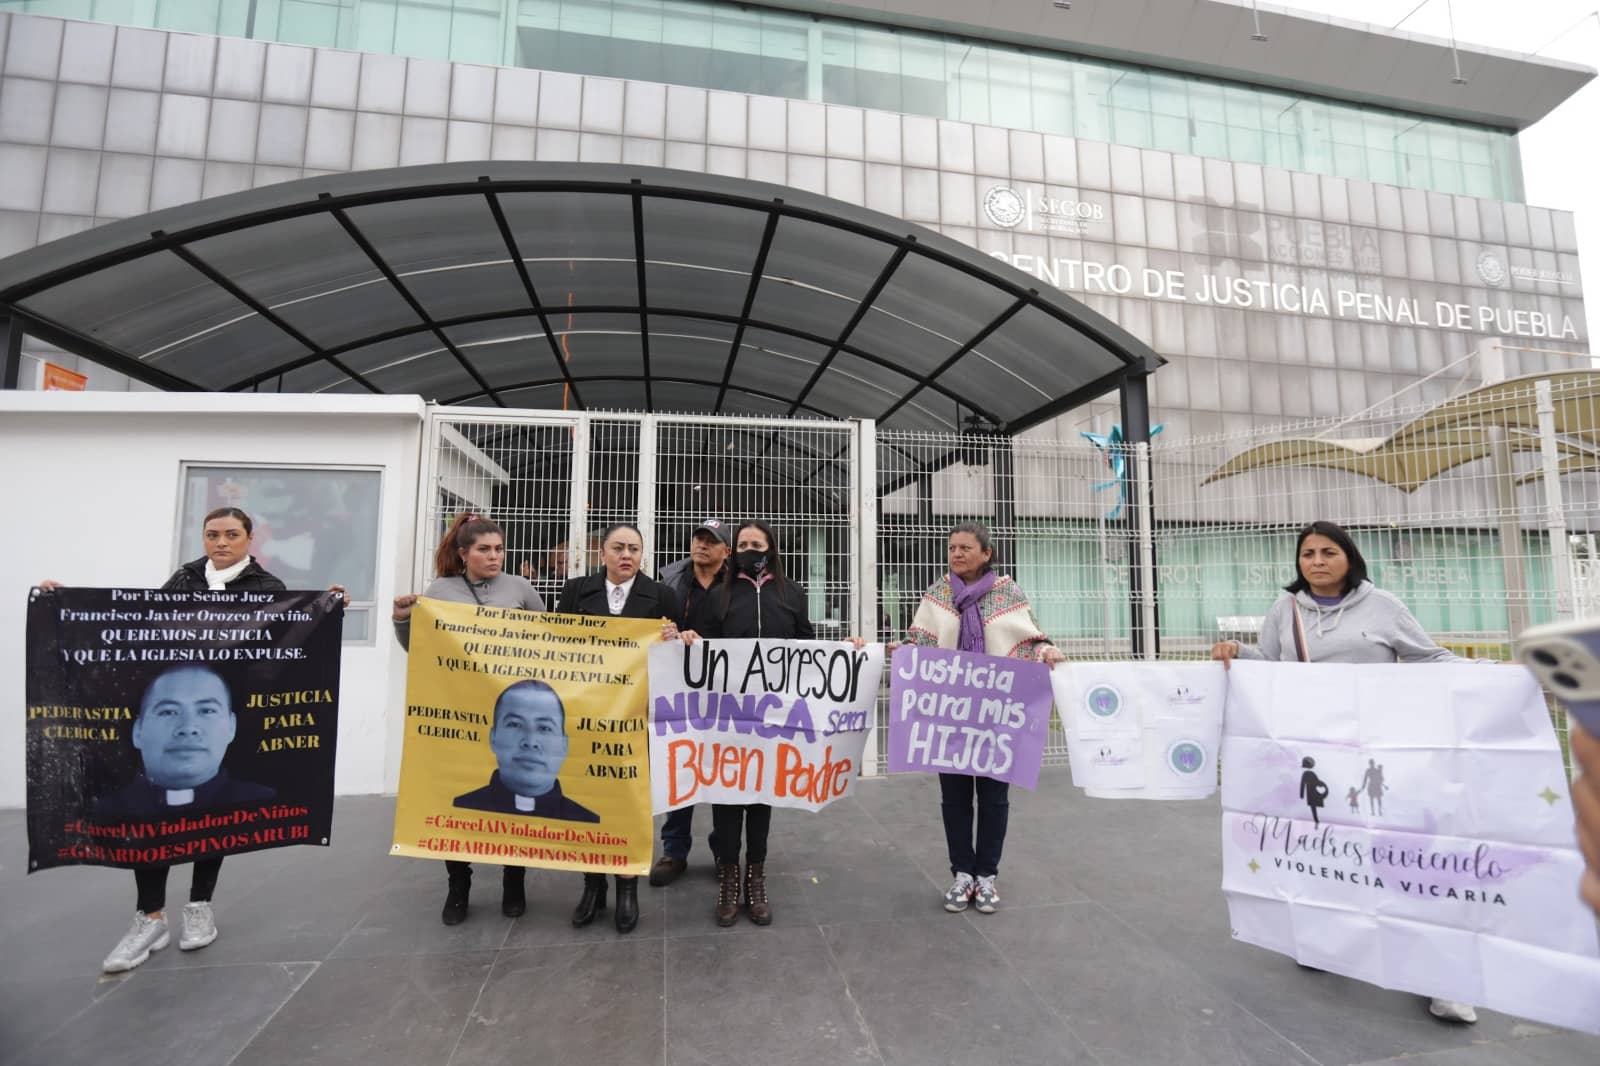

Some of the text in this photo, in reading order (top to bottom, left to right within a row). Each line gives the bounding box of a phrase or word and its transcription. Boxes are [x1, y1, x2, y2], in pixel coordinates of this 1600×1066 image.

[1039, 197, 1105, 220] SEGOB
[1142, 268, 1187, 300] DE
[1195, 274, 1329, 316] JUSTICIA
[1337, 290, 1429, 326] PENAL
[1435, 301, 1473, 330] DE
[1478, 306, 1579, 340] PUEBLA
[111, 589, 275, 602] Por Favor Señor Juez
[60, 608, 313, 622] Francisco Javier Orozco Treviño.
[476, 606, 608, 628] Por Favor Señor Juez
[101, 629, 273, 644] QUEREMOS JUSTICIA
[434, 618, 641, 649] Francisco Javier Orozco Treviño.
[74, 649, 111, 665] QUE
[115, 649, 138, 661] LA
[141, 649, 205, 661] IGLESIA
[208, 648, 231, 661] LO
[233, 648, 308, 660] EXPULSE.
[463, 642, 605, 665] QUEREMOS JUSTICIA
[437, 656, 635, 686] Y QUE LA IGLESIA LO EXPULSE.
[684, 640, 869, 703] Un Agresor
[898, 648, 1015, 693] Justicia
[246, 689, 333, 708] JUSTICIA
[29, 706, 132, 720] PEDERASTIA
[263, 712, 315, 730] PARA
[407, 705, 489, 726] PEDERASTIA
[654, 692, 817, 744] NUNCA
[44, 726, 120, 741] CLERICAL
[418, 724, 481, 742] CLERICAL
[576, 717, 645, 733] JUSTICIA
[256, 735, 320, 753] ABNER
[591, 741, 633, 756] PARA
[906, 722, 1013, 774] HIJOS
[585, 764, 638, 779] ABNER
[668, 739, 852, 806] Buen Padre
[417, 837, 629, 868] #GERARDOESPINOSARUBI
[1243, 814, 1511, 880] Madres viviendo
[1274, 857, 1508, 905] VIOLENCIA VICARIA
